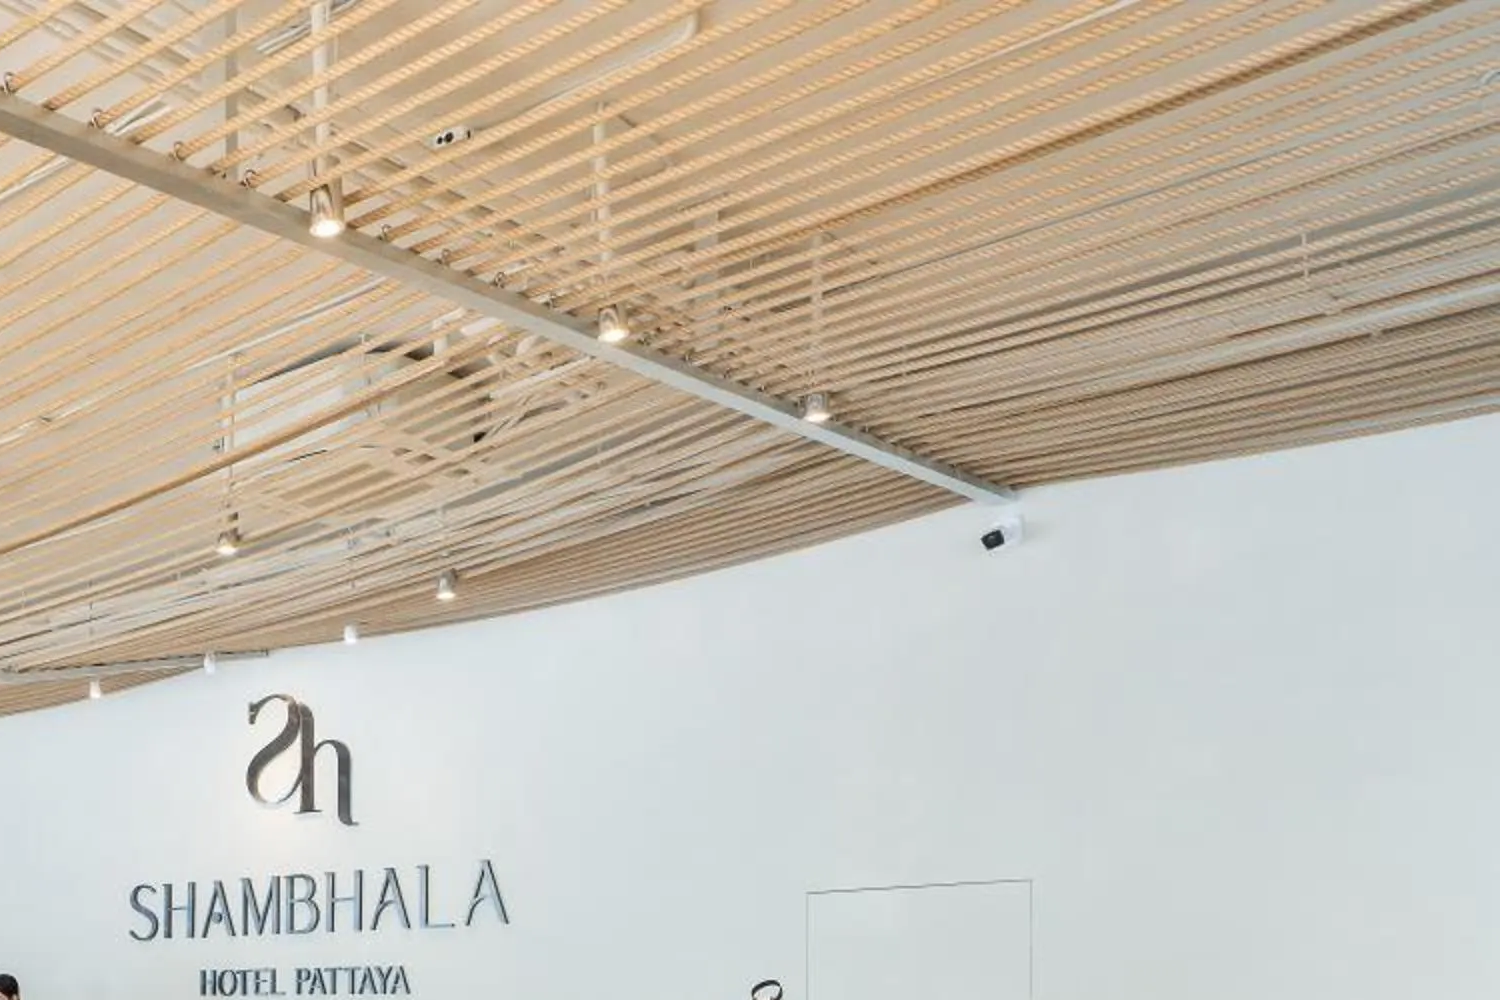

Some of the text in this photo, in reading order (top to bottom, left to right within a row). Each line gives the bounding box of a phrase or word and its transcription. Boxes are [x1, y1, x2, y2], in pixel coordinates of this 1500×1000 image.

[128, 858, 510, 941] SHAMBHALA
[199, 965, 411, 997] HOTEL PATTAYA
